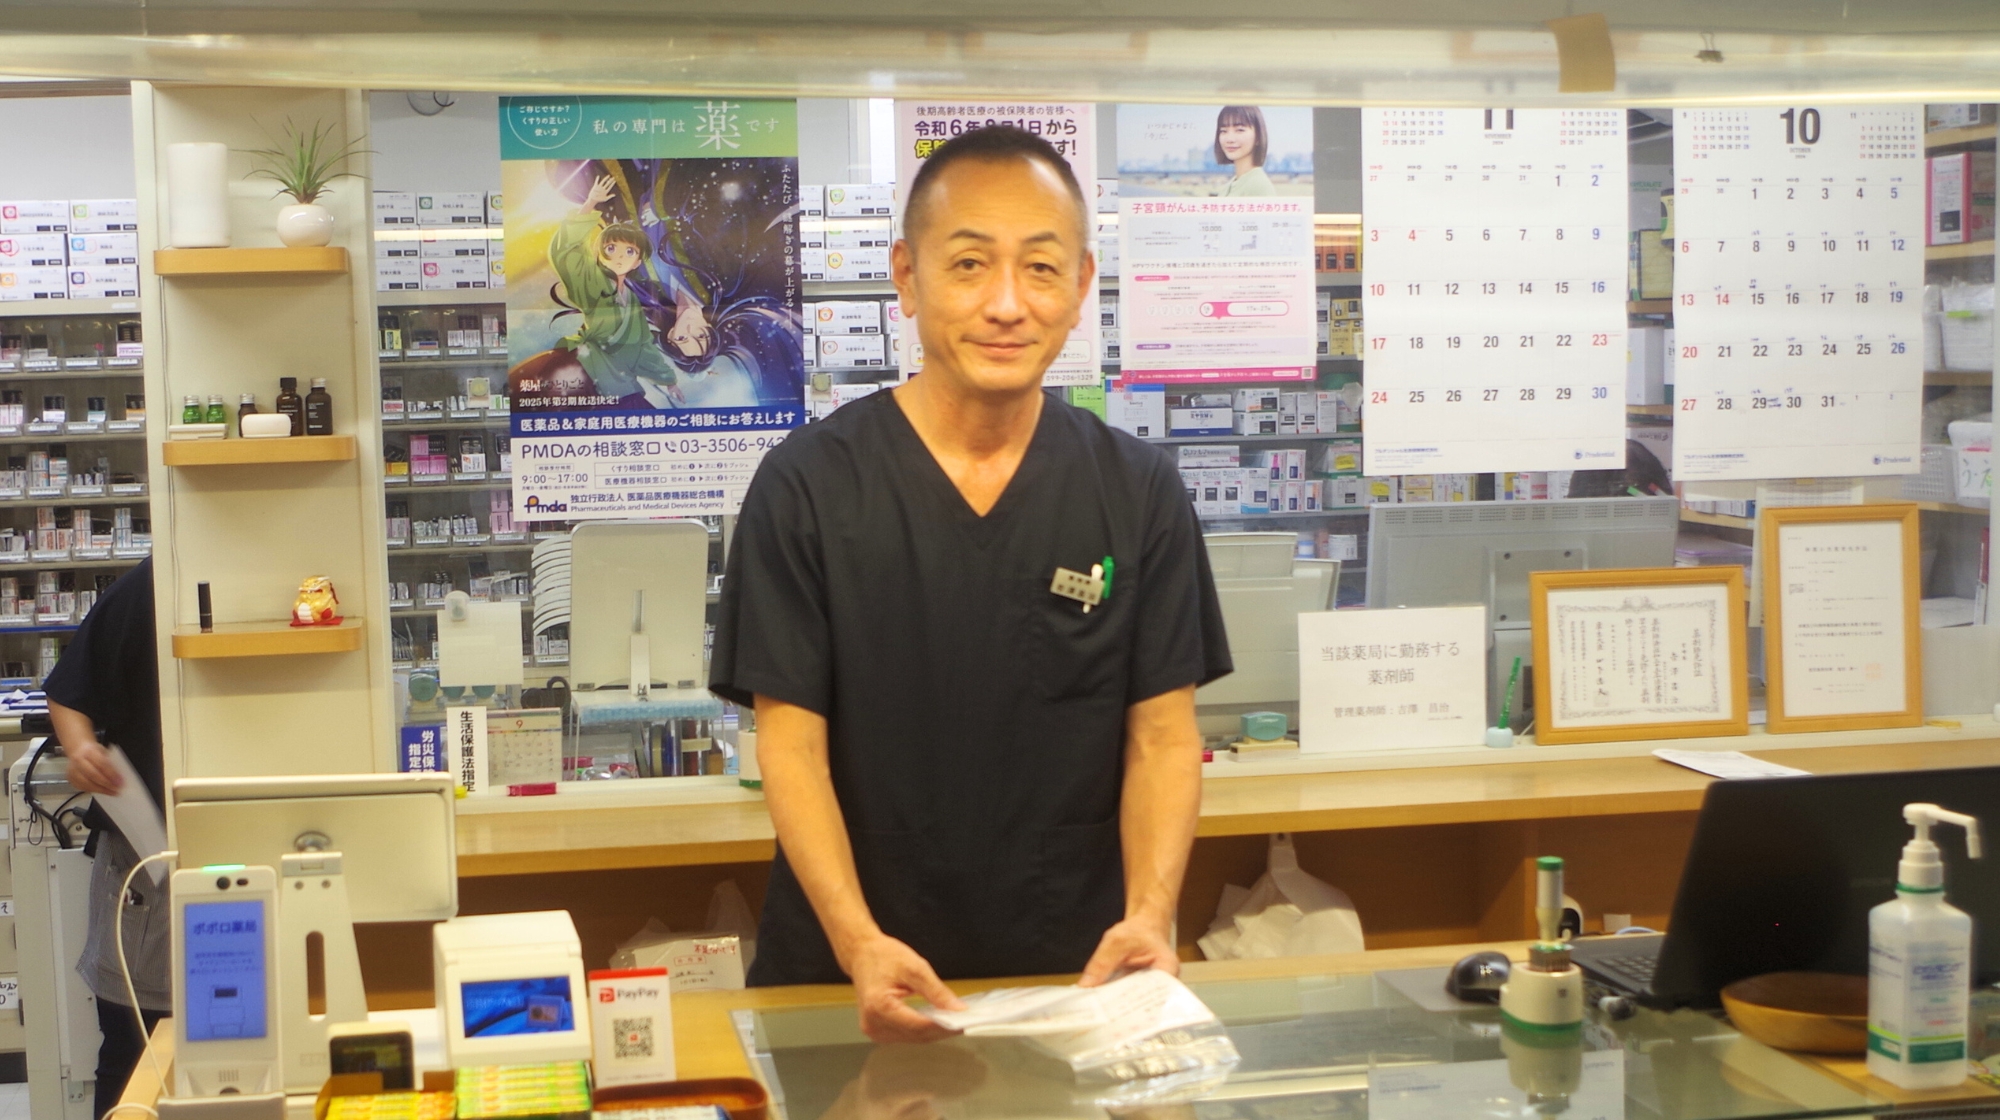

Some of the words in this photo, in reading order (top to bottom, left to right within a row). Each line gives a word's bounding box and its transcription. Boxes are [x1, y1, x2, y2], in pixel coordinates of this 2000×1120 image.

[916, 105, 1075, 116] 後期高齢者医療の被保険者の皆様へ
[534, 128, 558, 136] 使い方
[1780, 108, 1821, 145] 10
[1555, 175, 1560, 187] 1
[1591, 174, 1599, 187] 2
[1752, 188, 1757, 200] 1
[1787, 187, 1794, 200] 2
[1822, 187, 1829, 200] 3
[1856, 187, 1864, 199] 4
[1890, 187, 1898, 199] 5
[1132, 202, 1302, 214] 子宮頸がんは、予防する方法があります。
[1371, 229, 1379, 242] 3
[1408, 229, 1416, 241] 4
[1446, 229, 1453, 241] 5
[1483, 229, 1490, 241] 6
[1519, 229, 1527, 241] 7
[1556, 228, 1564, 241] 8
[1592, 228, 1600, 240] 9
[1682, 241, 1690, 253] 6
[1718, 241, 1725, 252] 7
[1752, 240, 1760, 253] 8
[1788, 240, 1795, 252] 9
[1823, 239, 1836, 252] 10
[1857, 239, 1869, 251] 11
[1891, 239, 1905, 251] 12
[1370, 283, 1385, 296] 10
[1408, 283, 1420, 295] 11
[1445, 283, 1459, 295] 12
[1482, 282, 1496, 295] 13
[1519, 282, 1532, 294] 14
[1555, 281, 1569, 294] 15
[1592, 281, 1605, 293] 16
[1680, 293, 1694, 306] 13
[1716, 293, 1730, 305] 14
[1751, 293, 1765, 305] 15
[1786, 292, 1800, 304] 16
[1821, 292, 1835, 304] 17
[1856, 291, 1869, 303] 18
[1890, 291, 1903, 303] 19
[1372, 337, 1386, 350] 17
[1409, 337, 1424, 349] 18
[1447, 336, 1461, 348] 19
[1483, 335, 1499, 348] 20
[1520, 335, 1534, 348] 21
[1556, 334, 1572, 347] 22
[1592, 333, 1608, 346] 23
[1682, 346, 1698, 358] 20
[1718, 345, 1731, 358] 21
[1753, 345, 1768, 357] 22
[1788, 344, 1803, 356] 23
[1823, 344, 1837, 355] 24
[1857, 343, 1871, 355] 25
[1891, 342, 1906, 354] 26
[519, 395, 620, 408] 2025年第2期放送決定!
[1372, 391, 1388, 404] 24
[1409, 390, 1425, 403] 25
[1446, 389, 1462, 402] 26
[1483, 389, 1499, 401] 27
[1520, 388, 1535, 401] 28
[1556, 387, 1572, 400] 29
[1592, 386, 1607, 399] 30
[1681, 398, 1697, 411] 27
[1717, 398, 1732, 410] 28
[1752, 397, 1767, 409] 29
[1786, 396, 1802, 408] 30
[1821, 395, 1835, 408] 31
[520, 411, 796, 432] 医薬品&家庭用医療機器のご相談にお答えします
[522, 440, 661, 459] PMDAの相談窓口
[570, 493, 624, 504] 独立行政法人
[571, 503, 626, 513] Pharmaceuticals
[628, 503, 641, 511] and
[643, 502, 670, 510] Medical
[671, 501, 697, 509] Devices
[699, 500, 725, 510] Agency
[1321, 641, 1461, 662] 当該薬局に勤務する
[1368, 668, 1415, 686] 薬剤師
[515, 719, 524, 729] 9
[408, 744, 422, 772] 指定
[421, 730, 435, 772] 労災保
[460, 711, 476, 792] 生活保護法指定
[617, 988, 659, 1000] PayPay
